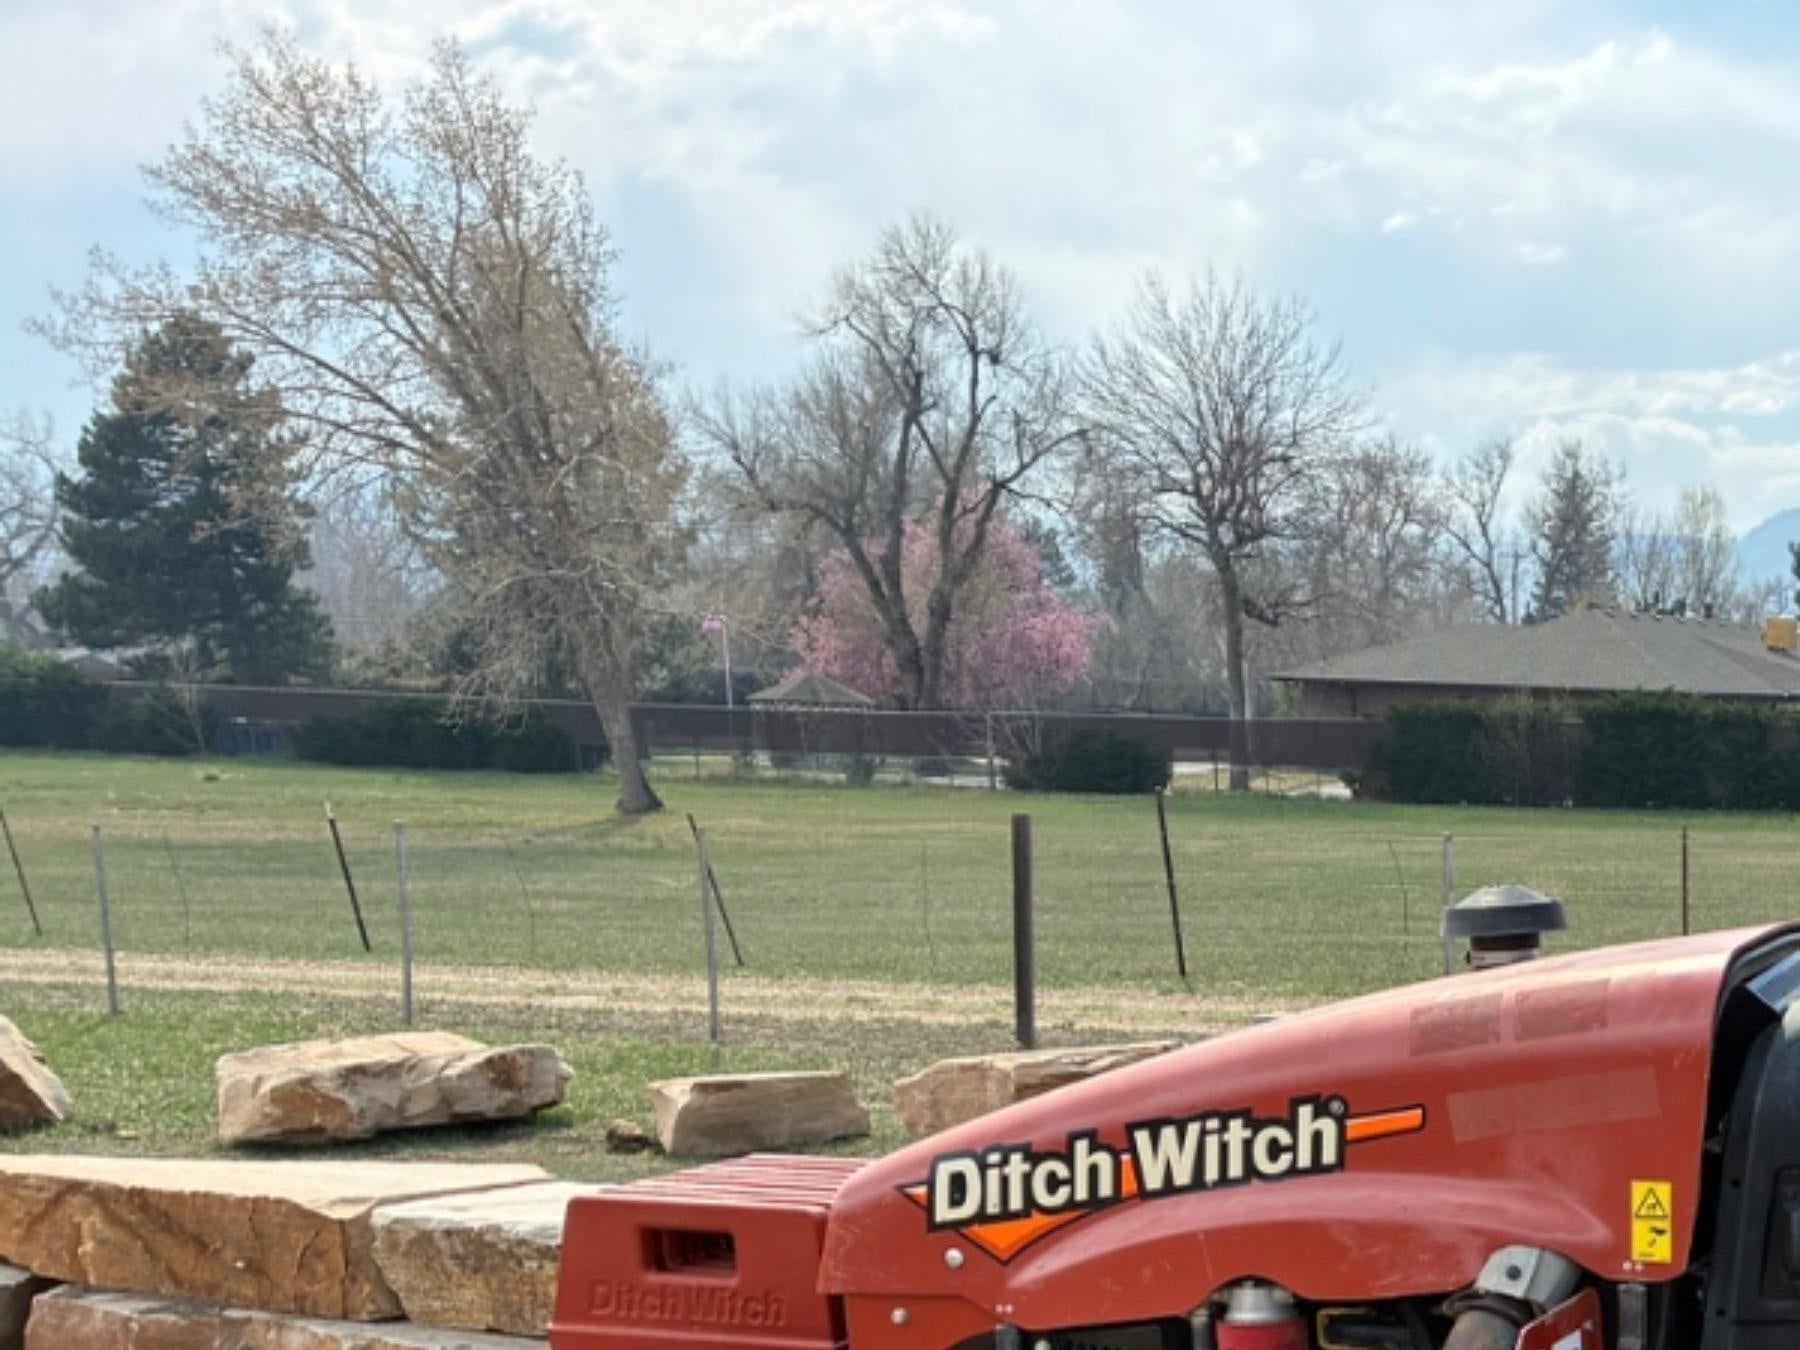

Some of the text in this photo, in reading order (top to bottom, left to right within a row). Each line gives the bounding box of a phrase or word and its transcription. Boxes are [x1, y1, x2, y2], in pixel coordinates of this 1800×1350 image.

[933, 1137, 1115, 1224] Ditch
[589, 1280, 787, 1327] Ditch Witch
